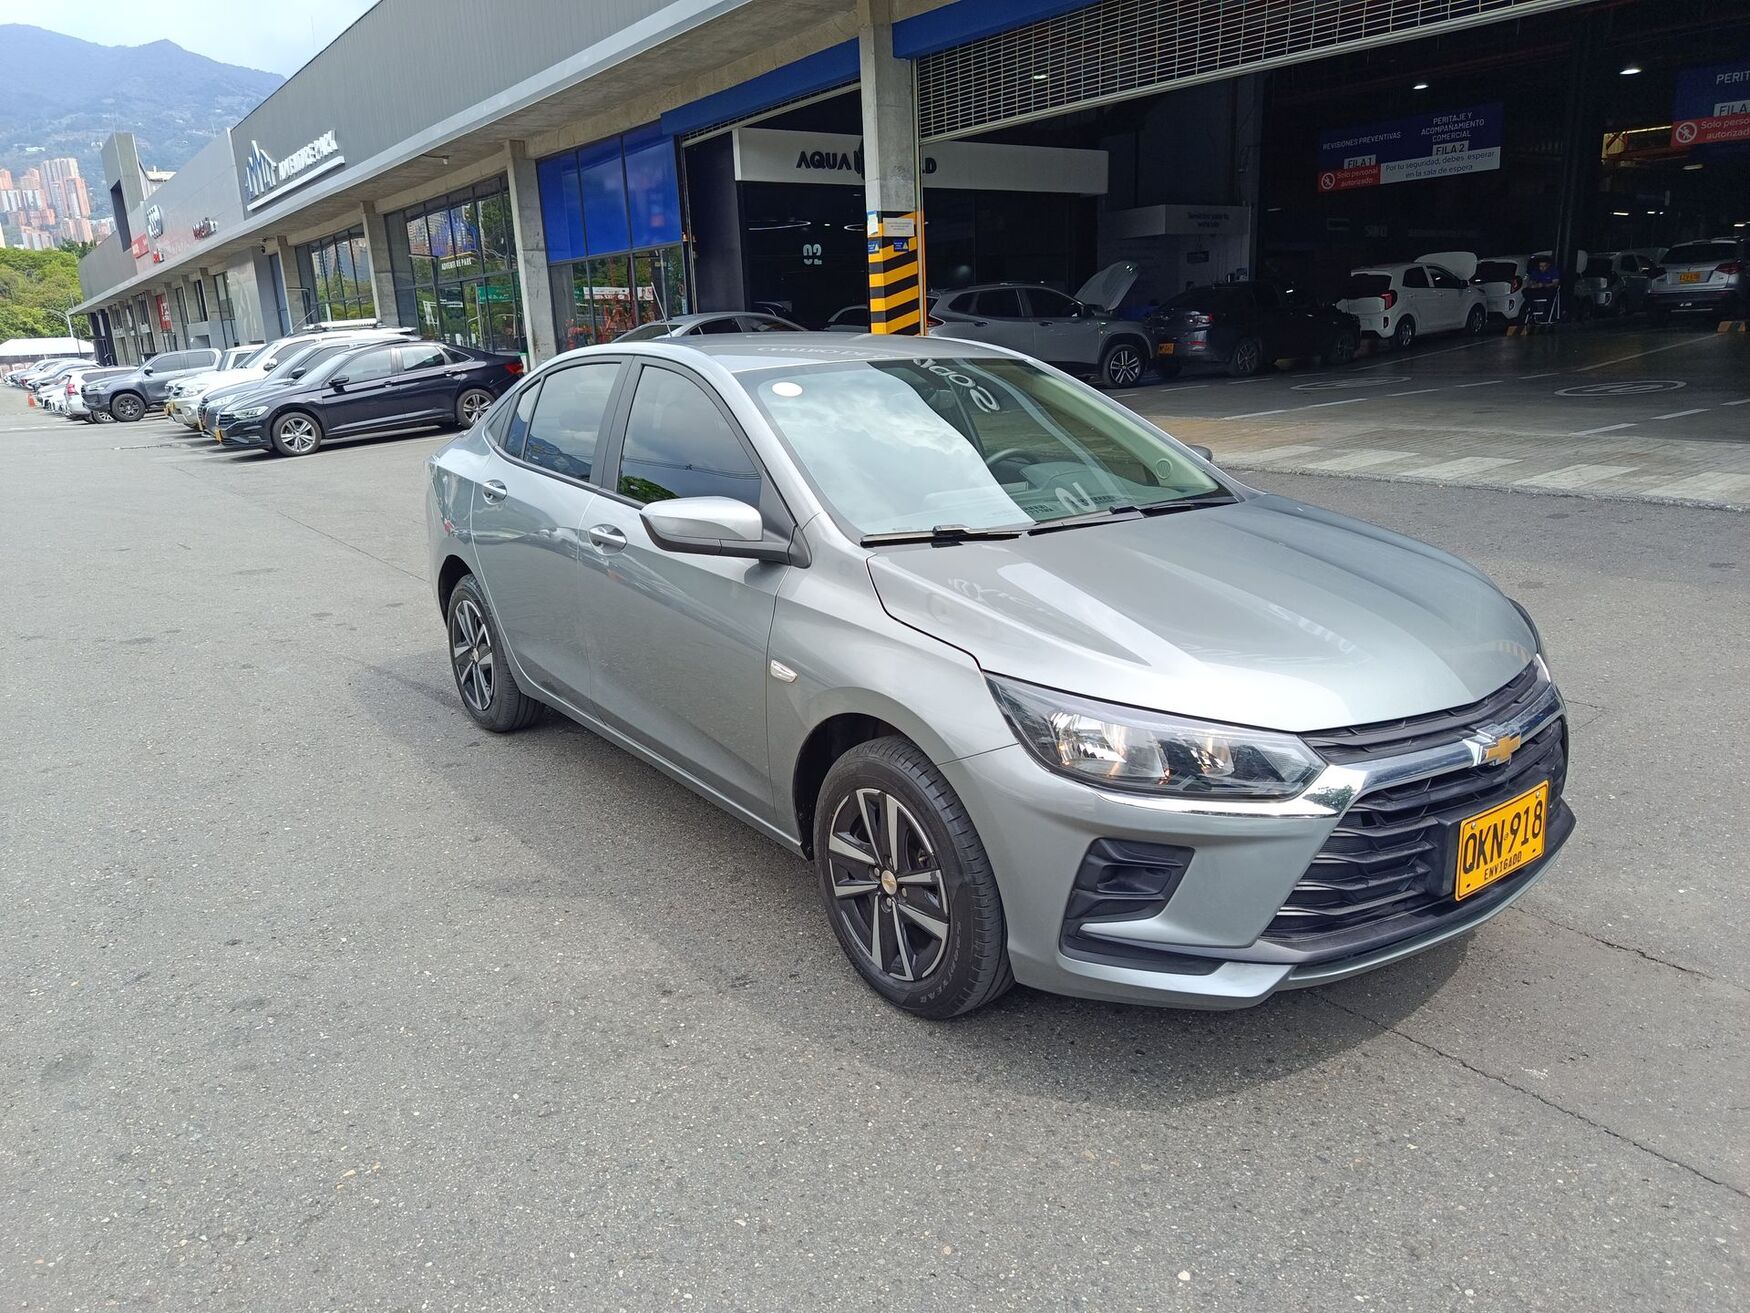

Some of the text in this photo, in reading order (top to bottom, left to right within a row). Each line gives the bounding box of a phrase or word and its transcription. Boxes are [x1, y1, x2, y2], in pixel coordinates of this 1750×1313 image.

[1359, 131, 1402, 145] PREVENTIVAS
[1432, 130, 1472, 143] COMERCIAL
[1435, 143, 1465, 156] FILA 2
[796, 150, 851, 171] AQUA
[1348, 158, 1367, 168] FILA
[1467, 151, 1495, 163] esperar
[1422, 167, 1437, 177] sala
[1437, 165, 1448, 175] de
[1448, 164, 1473, 175] espera
[1484, 851, 1522, 881] ENVIGADO
